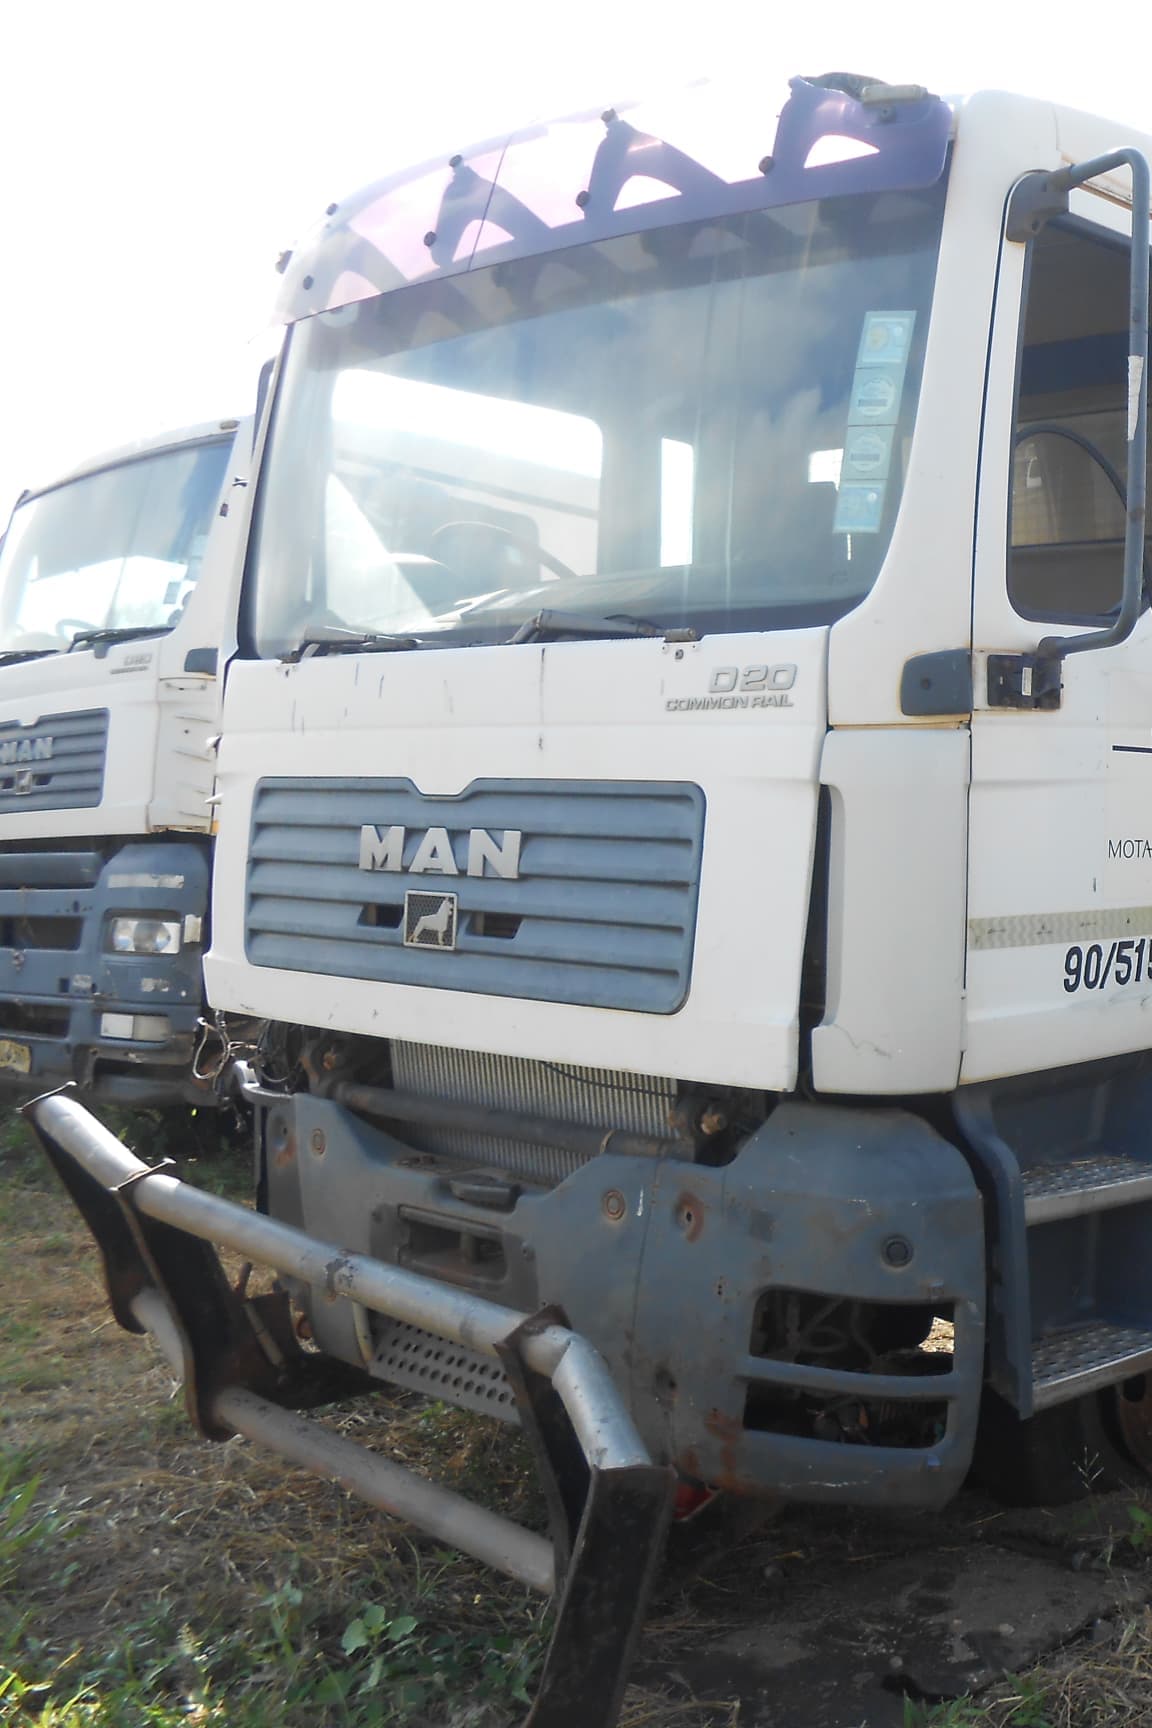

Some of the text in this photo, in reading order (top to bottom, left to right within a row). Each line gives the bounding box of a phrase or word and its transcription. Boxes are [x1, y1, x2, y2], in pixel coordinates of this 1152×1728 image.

[709, 663, 798, 693] D20
[665, 694, 795, 712] COMMON RAIL
[0, 736, 53, 764] MAN
[359, 824, 522, 879] MAN
